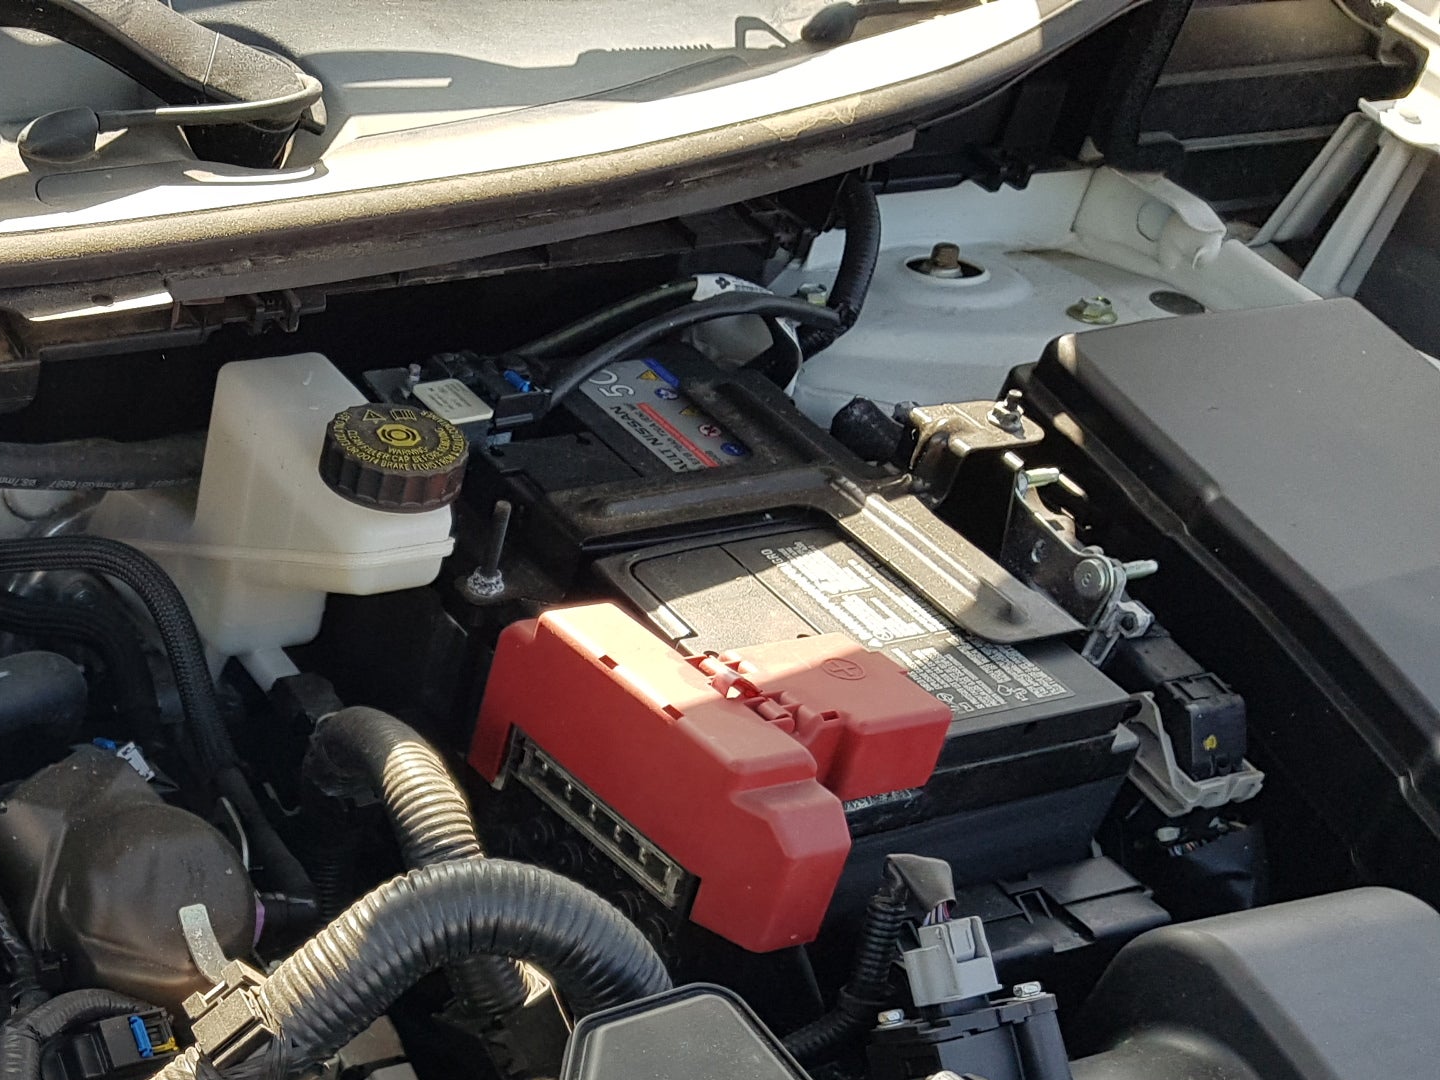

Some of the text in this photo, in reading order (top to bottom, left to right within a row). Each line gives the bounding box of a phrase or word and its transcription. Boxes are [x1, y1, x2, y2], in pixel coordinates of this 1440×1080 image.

[610, 405, 664, 447] NISSAN
[388, 446, 428, 456] WARNING
[391, 454, 410, 463] CAP
[411, 450, 444, 463] BEFORE
[356, 452, 380, 464] DOT4
[380, 460, 410, 470] BRAKE
